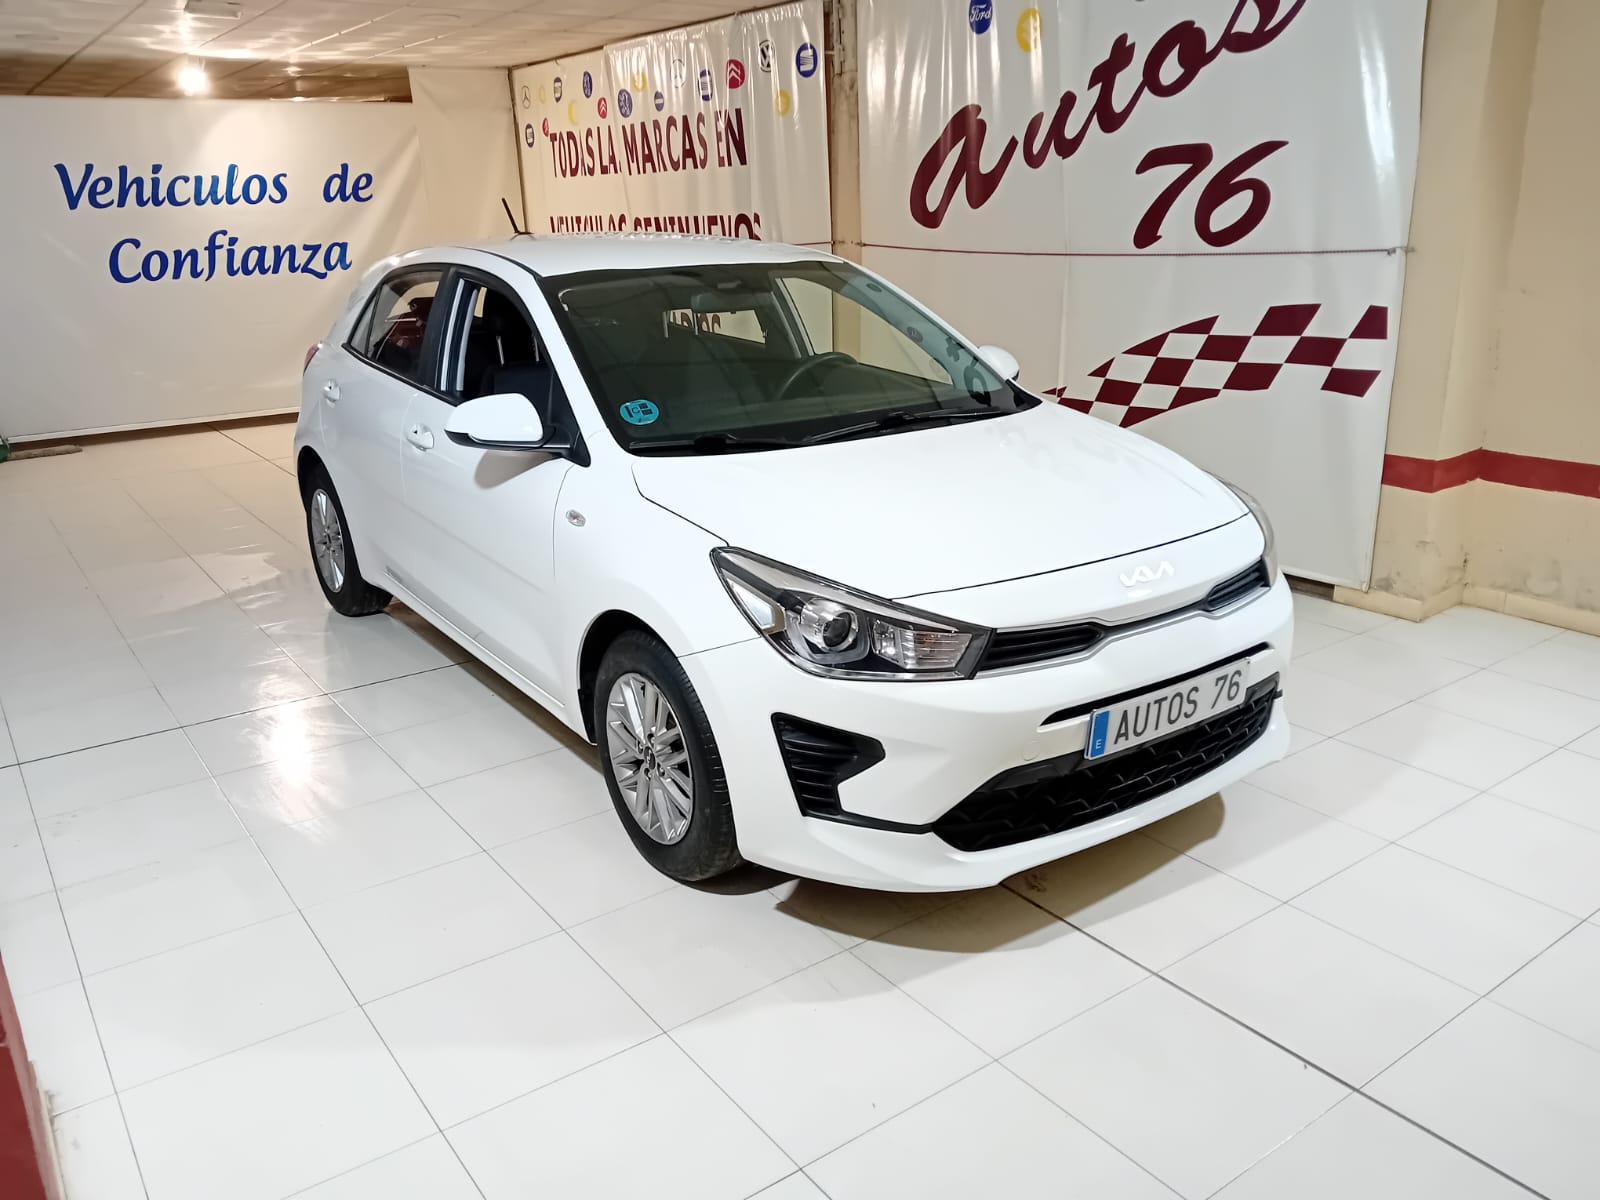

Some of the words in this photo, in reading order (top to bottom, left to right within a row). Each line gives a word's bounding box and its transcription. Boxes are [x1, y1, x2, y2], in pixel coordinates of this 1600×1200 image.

[969, 4, 992, 22] Ford
[622, 111, 708, 176] MARCAS
[715, 107, 748, 168] EN
[54, 163, 288, 210] Vehiculos
[323, 163, 373, 203] de
[1134, 140, 1289, 249] 76
[109, 229, 352, 284] Confianza
[1114, 686, 1199, 745] AUTOS
[1211, 669, 1242, 710] 76
[1096, 738, 1102, 749] E
